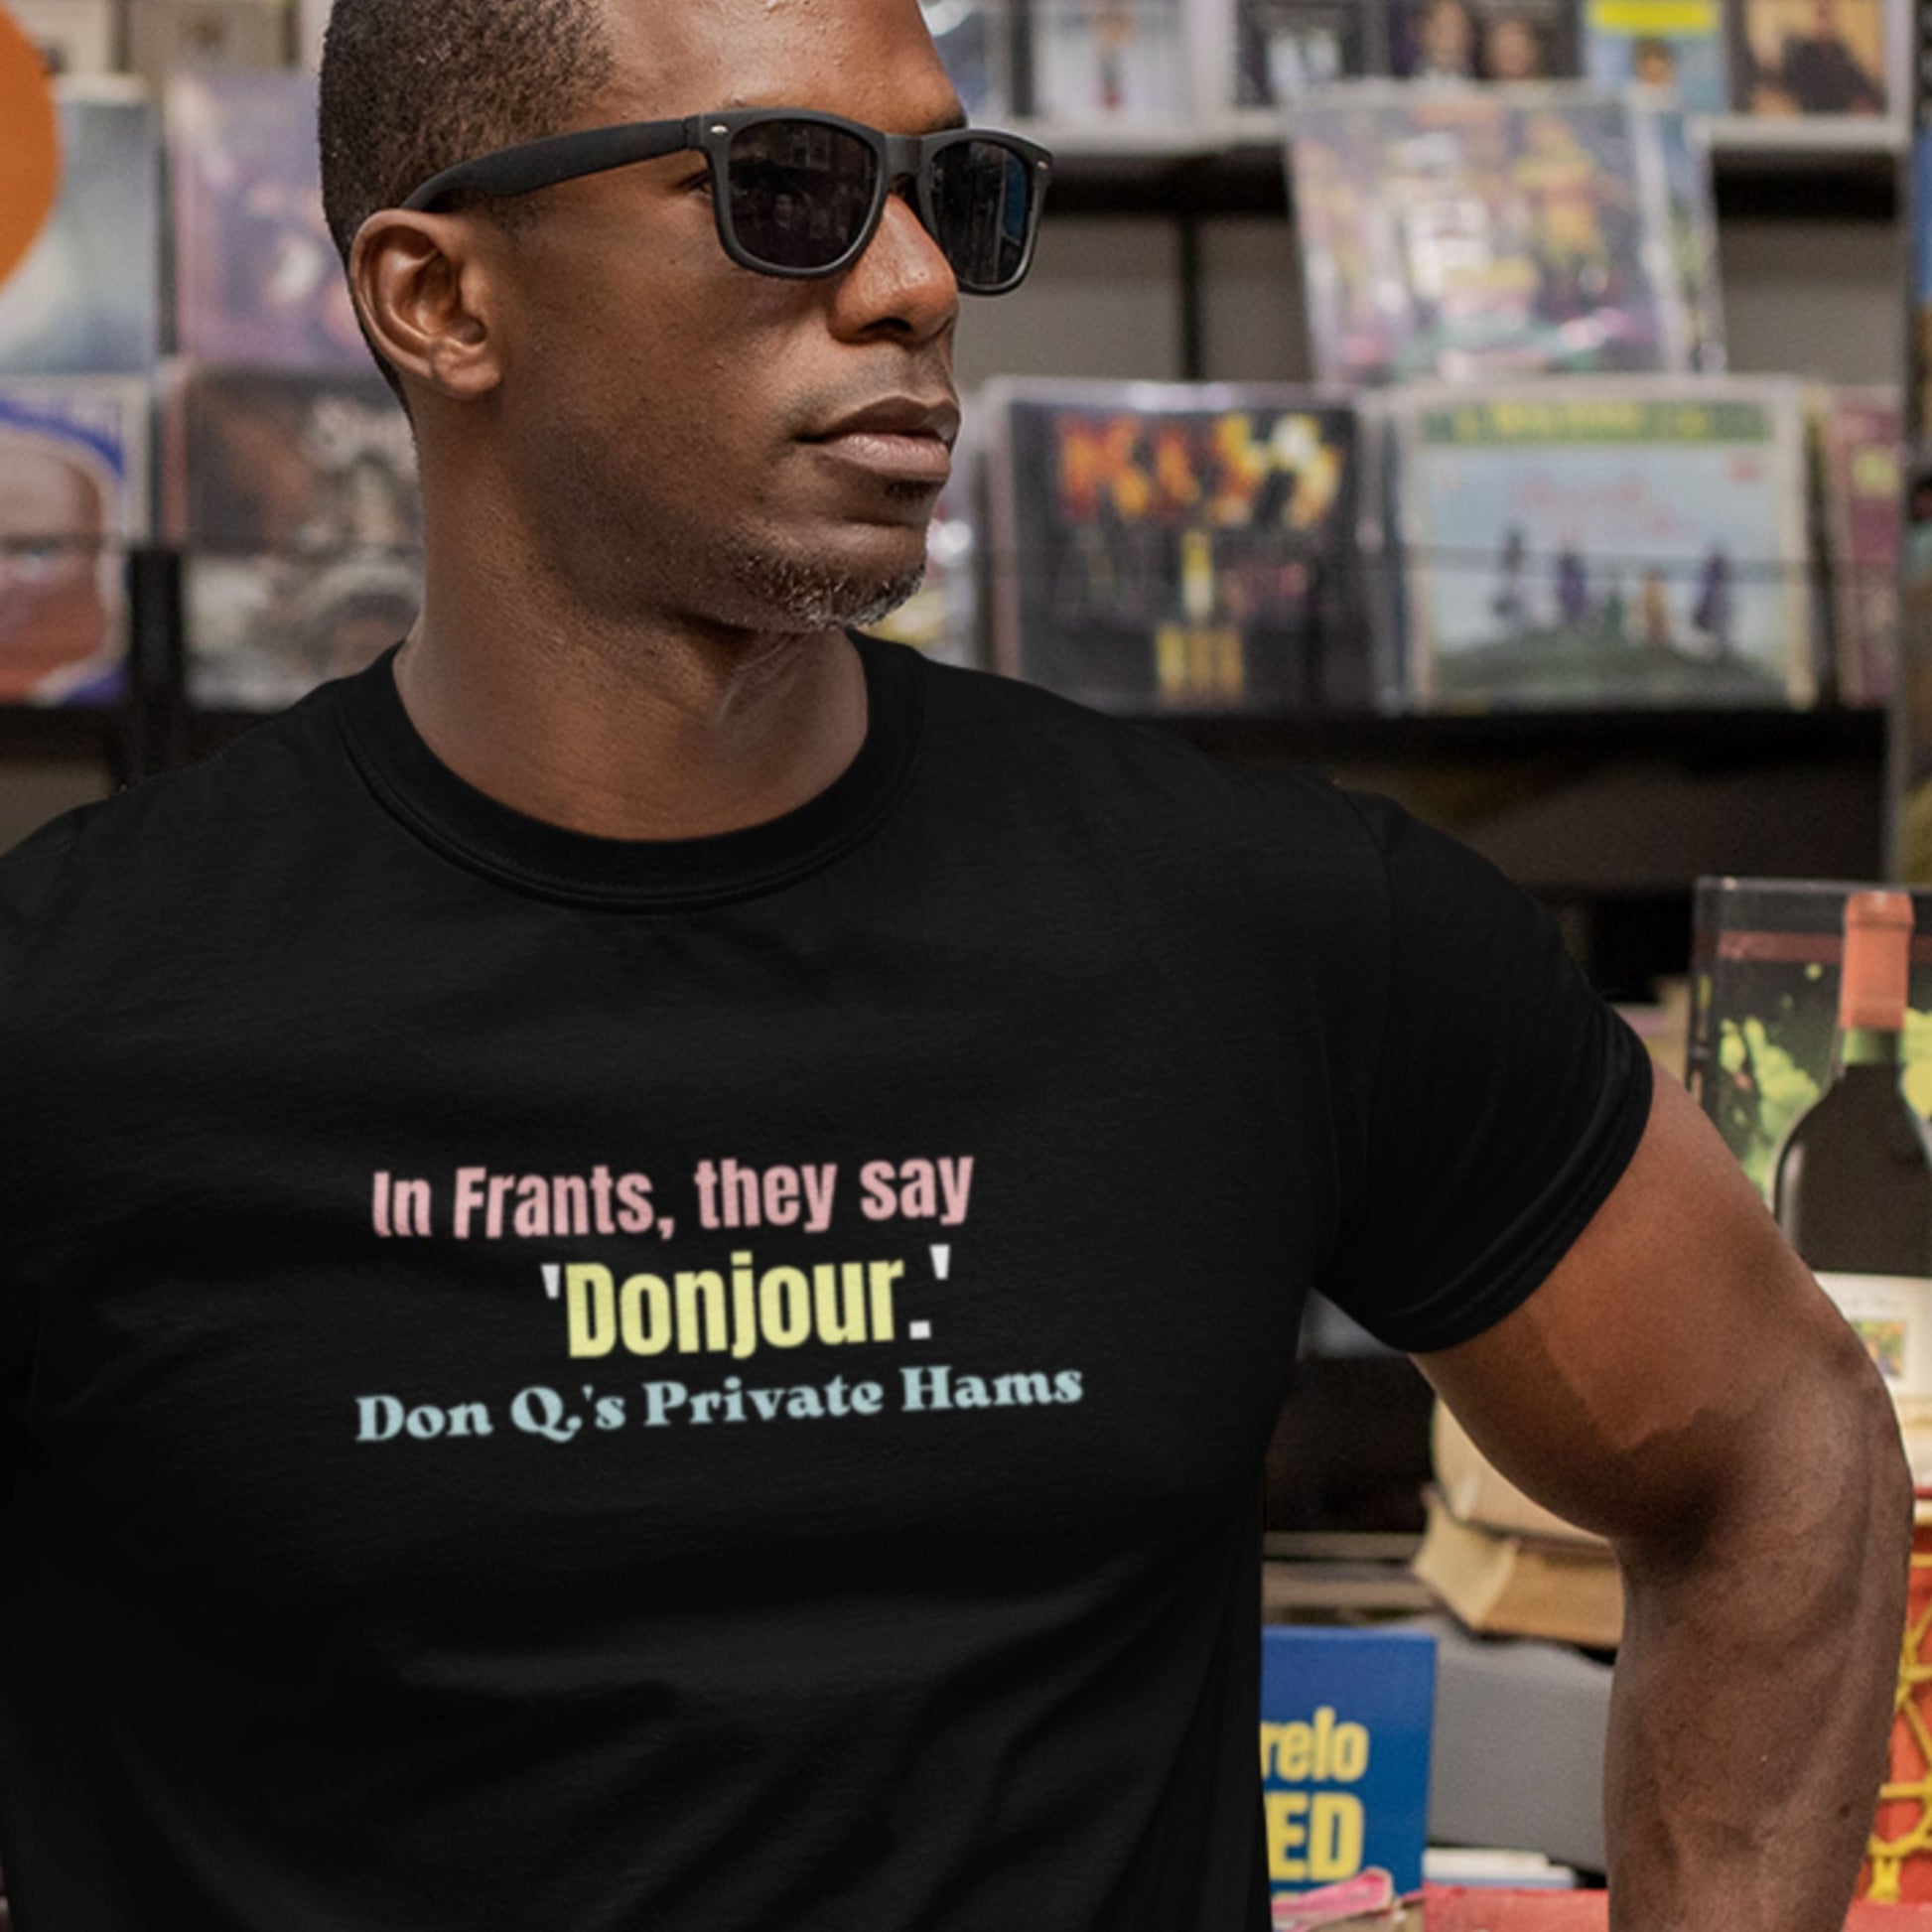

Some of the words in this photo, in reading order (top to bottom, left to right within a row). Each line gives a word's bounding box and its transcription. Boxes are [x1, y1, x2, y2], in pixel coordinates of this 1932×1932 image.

[1057, 410, 1342, 525] KISS
[372, 1171, 432, 1237] In
[453, 1165, 675, 1241] Frants,
[693, 1158, 838, 1233] they
[859, 1156, 974, 1226] say
[356, 1395, 493, 1443] Don
[642, 1375, 884, 1427] Private
[899, 1365, 1083, 1412] Hams
[1263, 1790, 1364, 1882] ED
